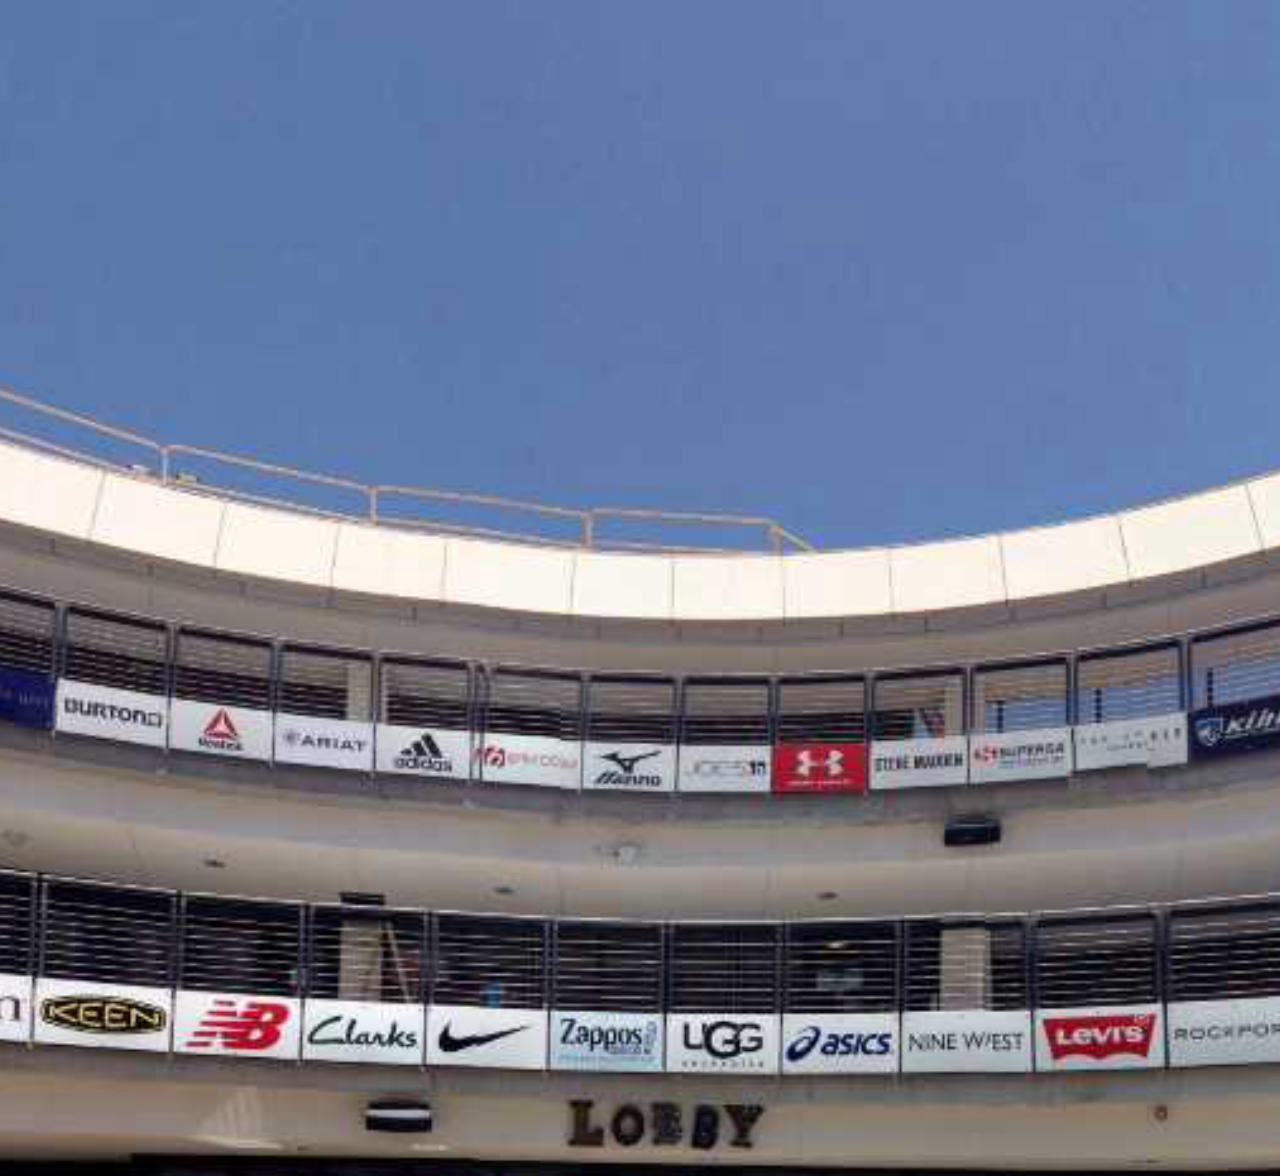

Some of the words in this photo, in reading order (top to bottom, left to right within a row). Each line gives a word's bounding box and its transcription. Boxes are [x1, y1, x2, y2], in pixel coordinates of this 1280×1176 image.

[64, 697, 147, 726] BURTON
[393, 756, 453, 773] adidas
[49, 1003, 160, 1031] KEEN
[307, 1016, 418, 1049] Clarks
[560, 1018, 643, 1052] Zappos
[683, 1021, 764, 1060] UGG
[908, 1033, 957, 1052] NINE
[965, 1031, 1024, 1051] WEST
[567, 1100, 765, 1149] LOBBY
